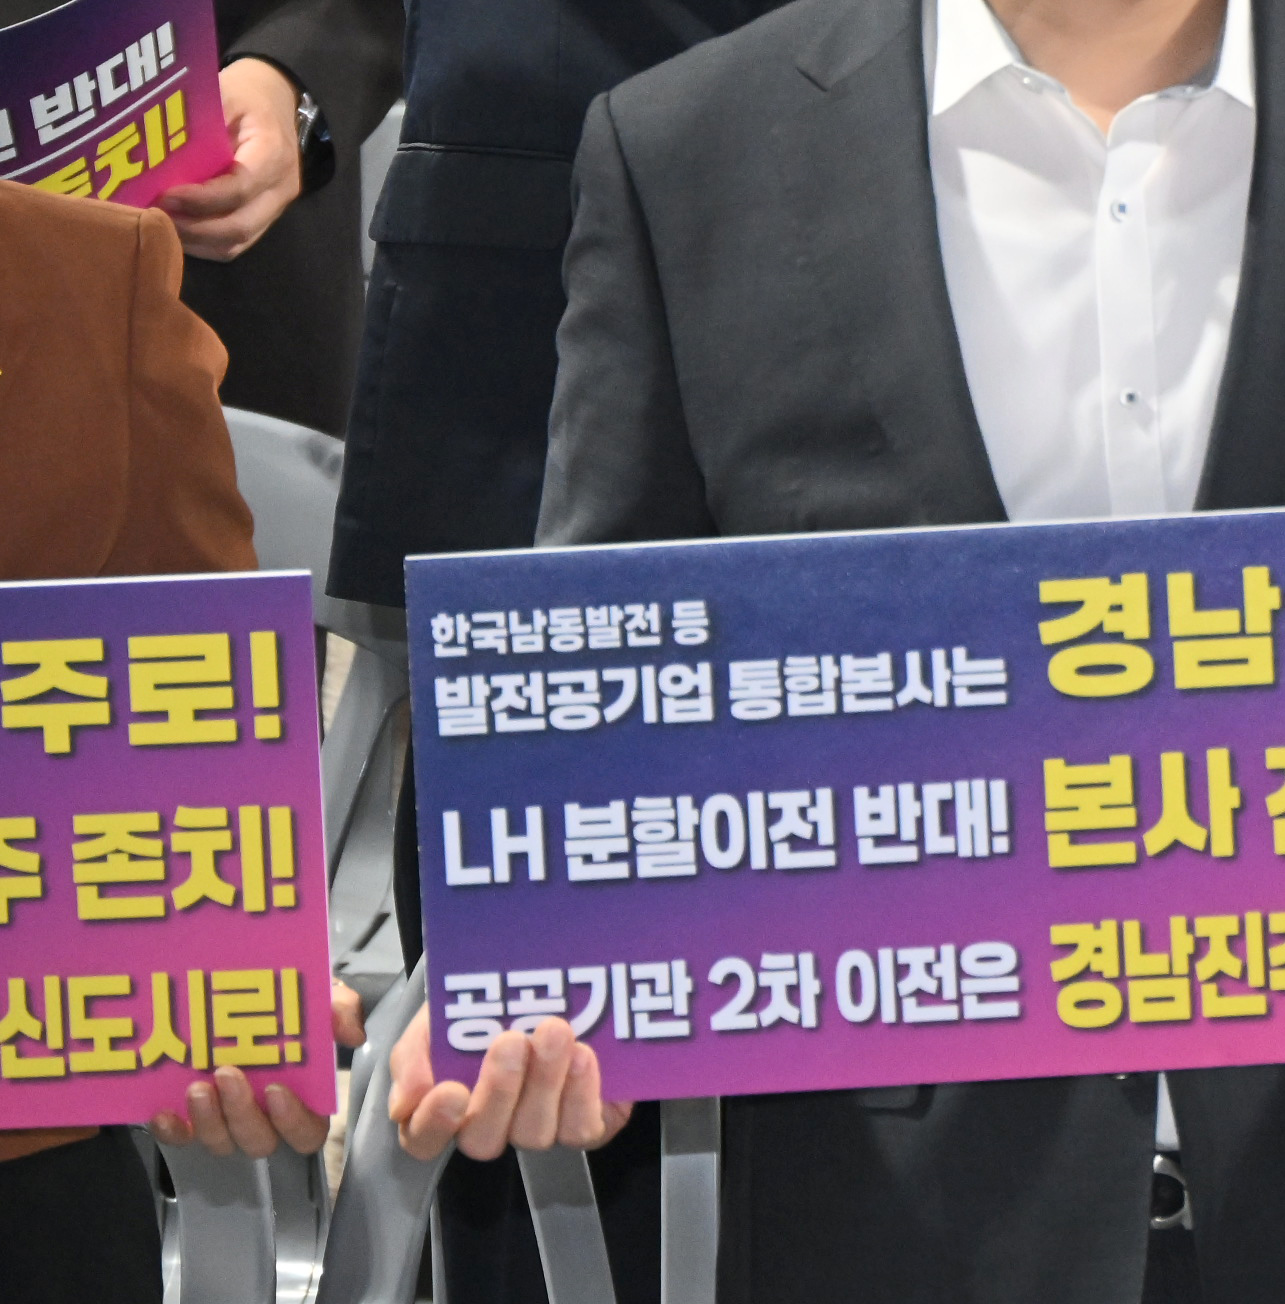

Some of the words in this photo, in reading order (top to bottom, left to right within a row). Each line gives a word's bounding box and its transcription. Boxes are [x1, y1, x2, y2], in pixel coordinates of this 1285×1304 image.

[29, 21, 175, 146] 반대!
[430, 605, 660, 658] 한국남동발전
[670, 601, 710, 645] 등
[0, 630, 282, 754] 주로!
[434, 662, 714, 737] 발전공기업
[728, 648, 1007, 722] 통합본사는
[71, 805, 297, 922] 존치!
[442, 805, 546, 887] LH
[563, 786, 836, 883] 분할이전
[853, 779, 1009, 862] 반대!
[1042, 747, 1241, 869] 본사
[442, 960, 692, 1051] 공공기관
[709, 954, 819, 1030] 2차
[835, 942, 1020, 1024] 이전은
